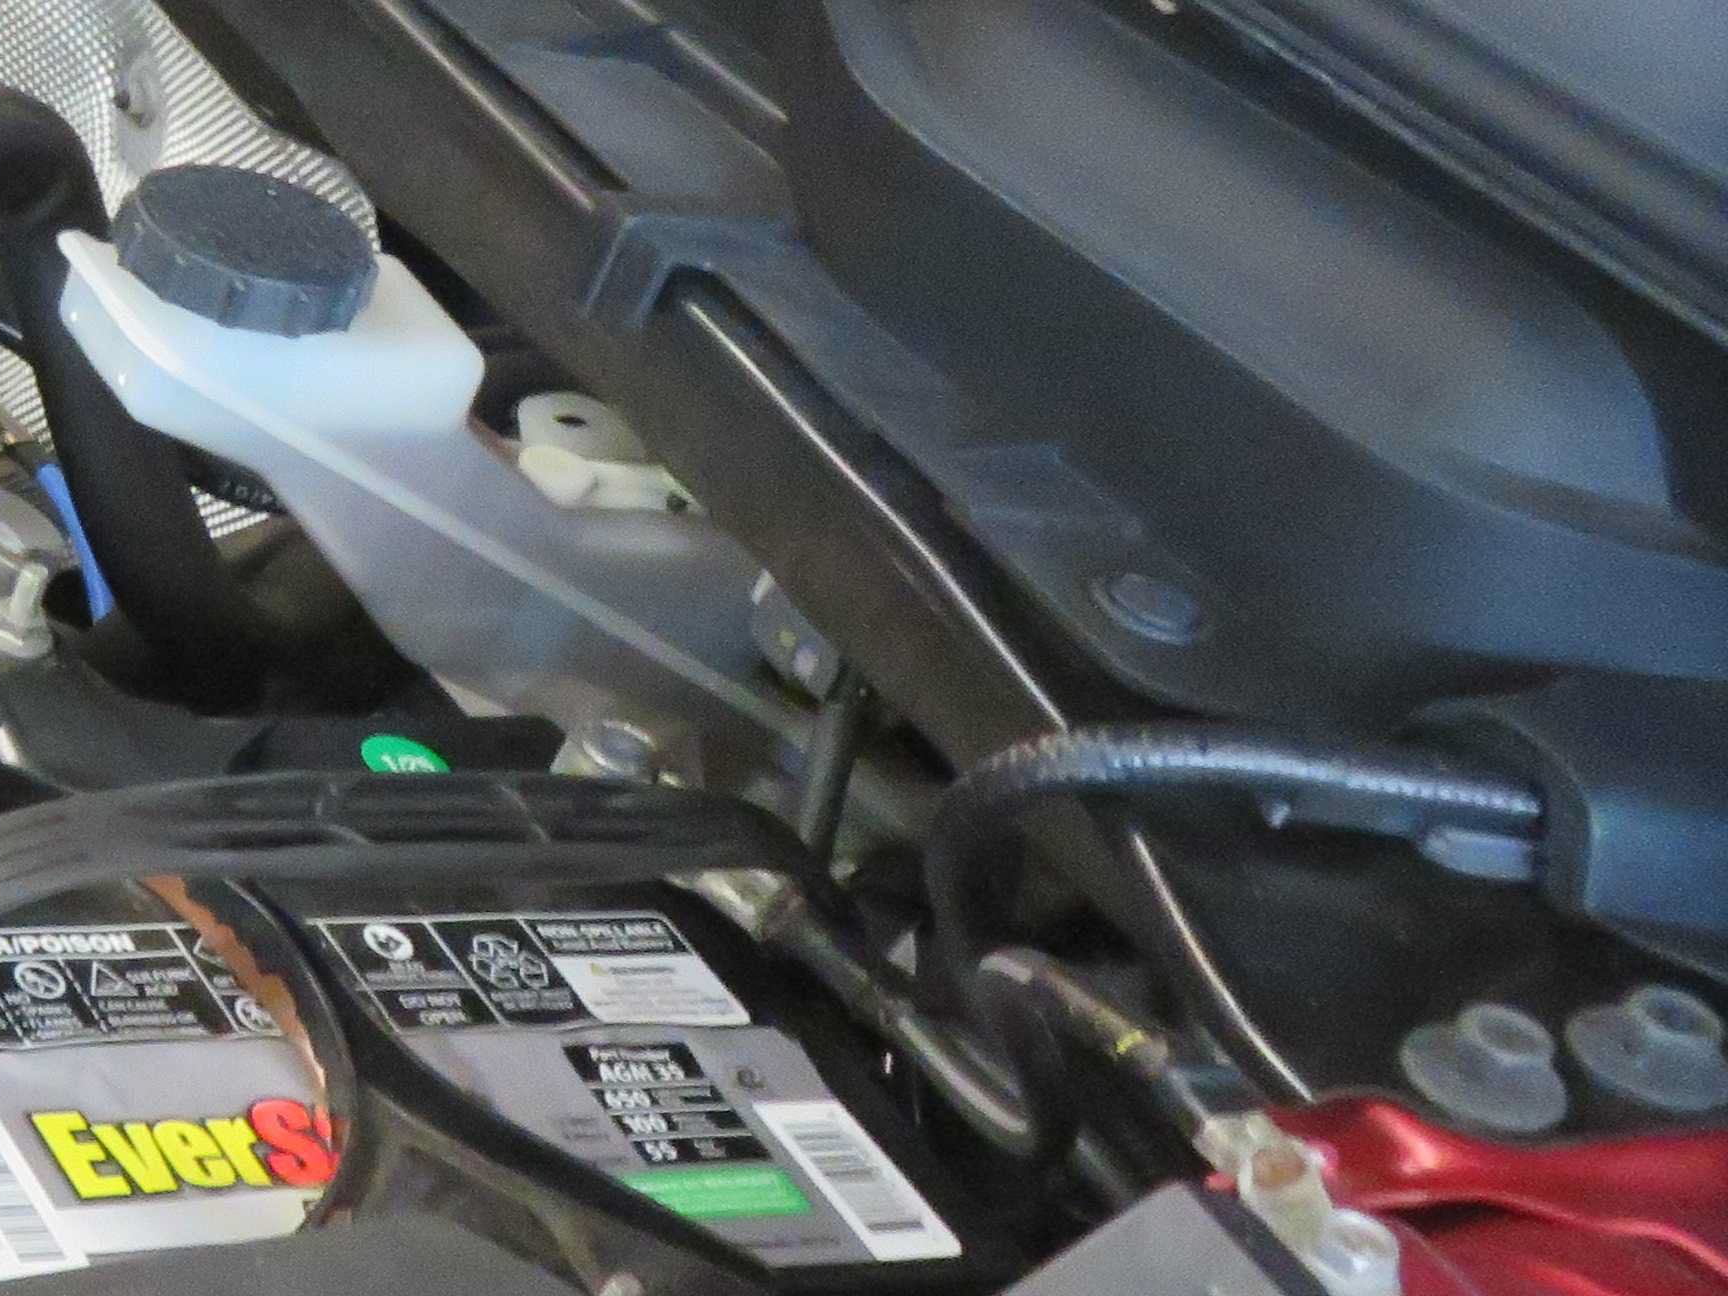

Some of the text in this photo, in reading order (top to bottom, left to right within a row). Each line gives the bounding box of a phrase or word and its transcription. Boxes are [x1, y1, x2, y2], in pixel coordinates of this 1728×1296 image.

[598, 1061, 653, 1083] AGM
[602, 1088, 652, 1108] 650
[622, 1112, 670, 1134] 100
[29, 1097, 341, 1199] EverS
